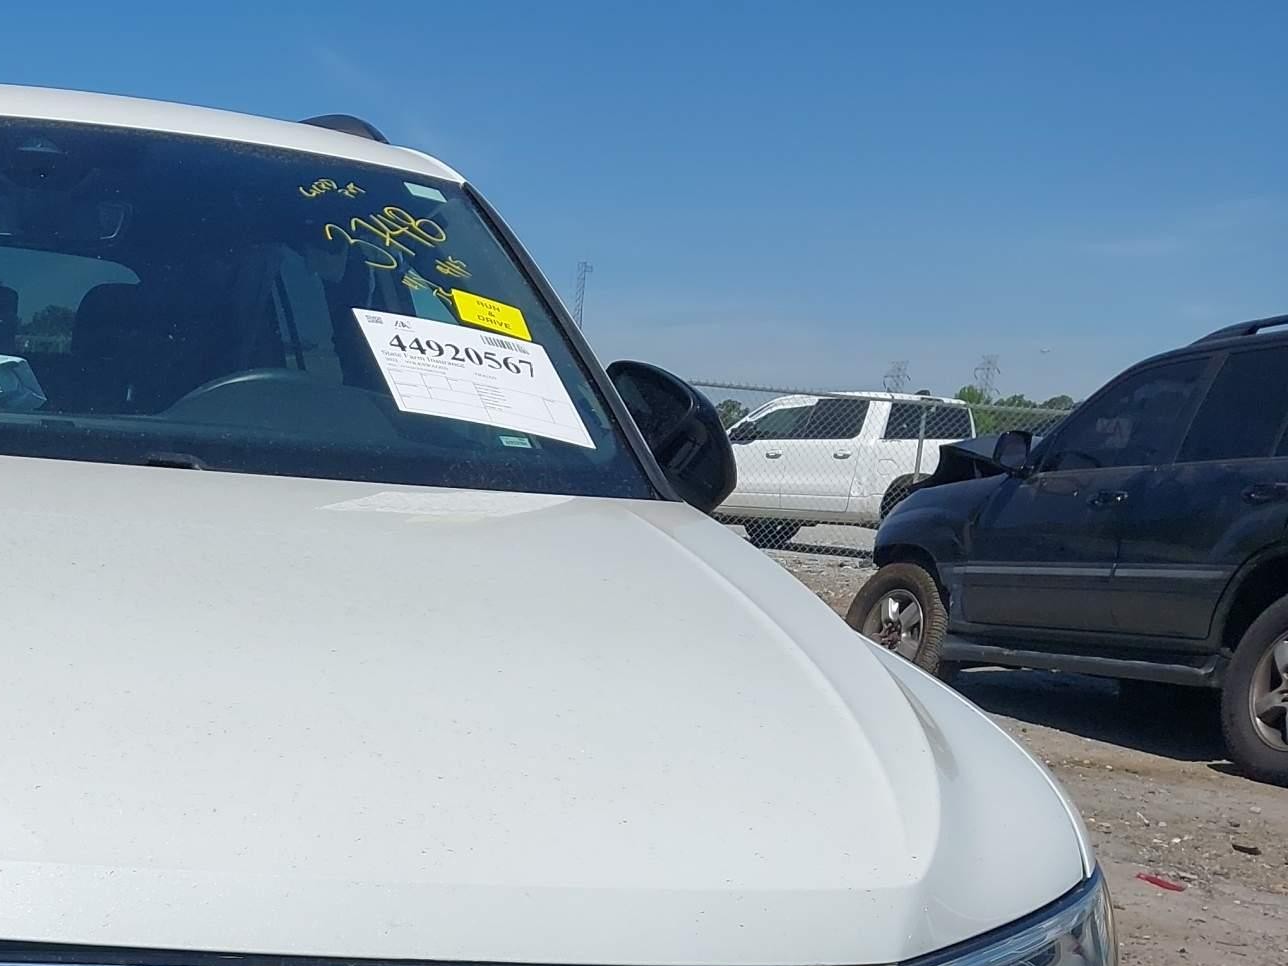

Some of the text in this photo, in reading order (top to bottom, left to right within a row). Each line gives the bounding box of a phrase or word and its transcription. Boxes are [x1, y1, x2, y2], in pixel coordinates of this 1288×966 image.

[475, 300, 501, 313] RUN
[487, 310, 496, 318] &
[476, 314, 512, 330] DRIVE
[388, 334, 534, 378] 44920567
